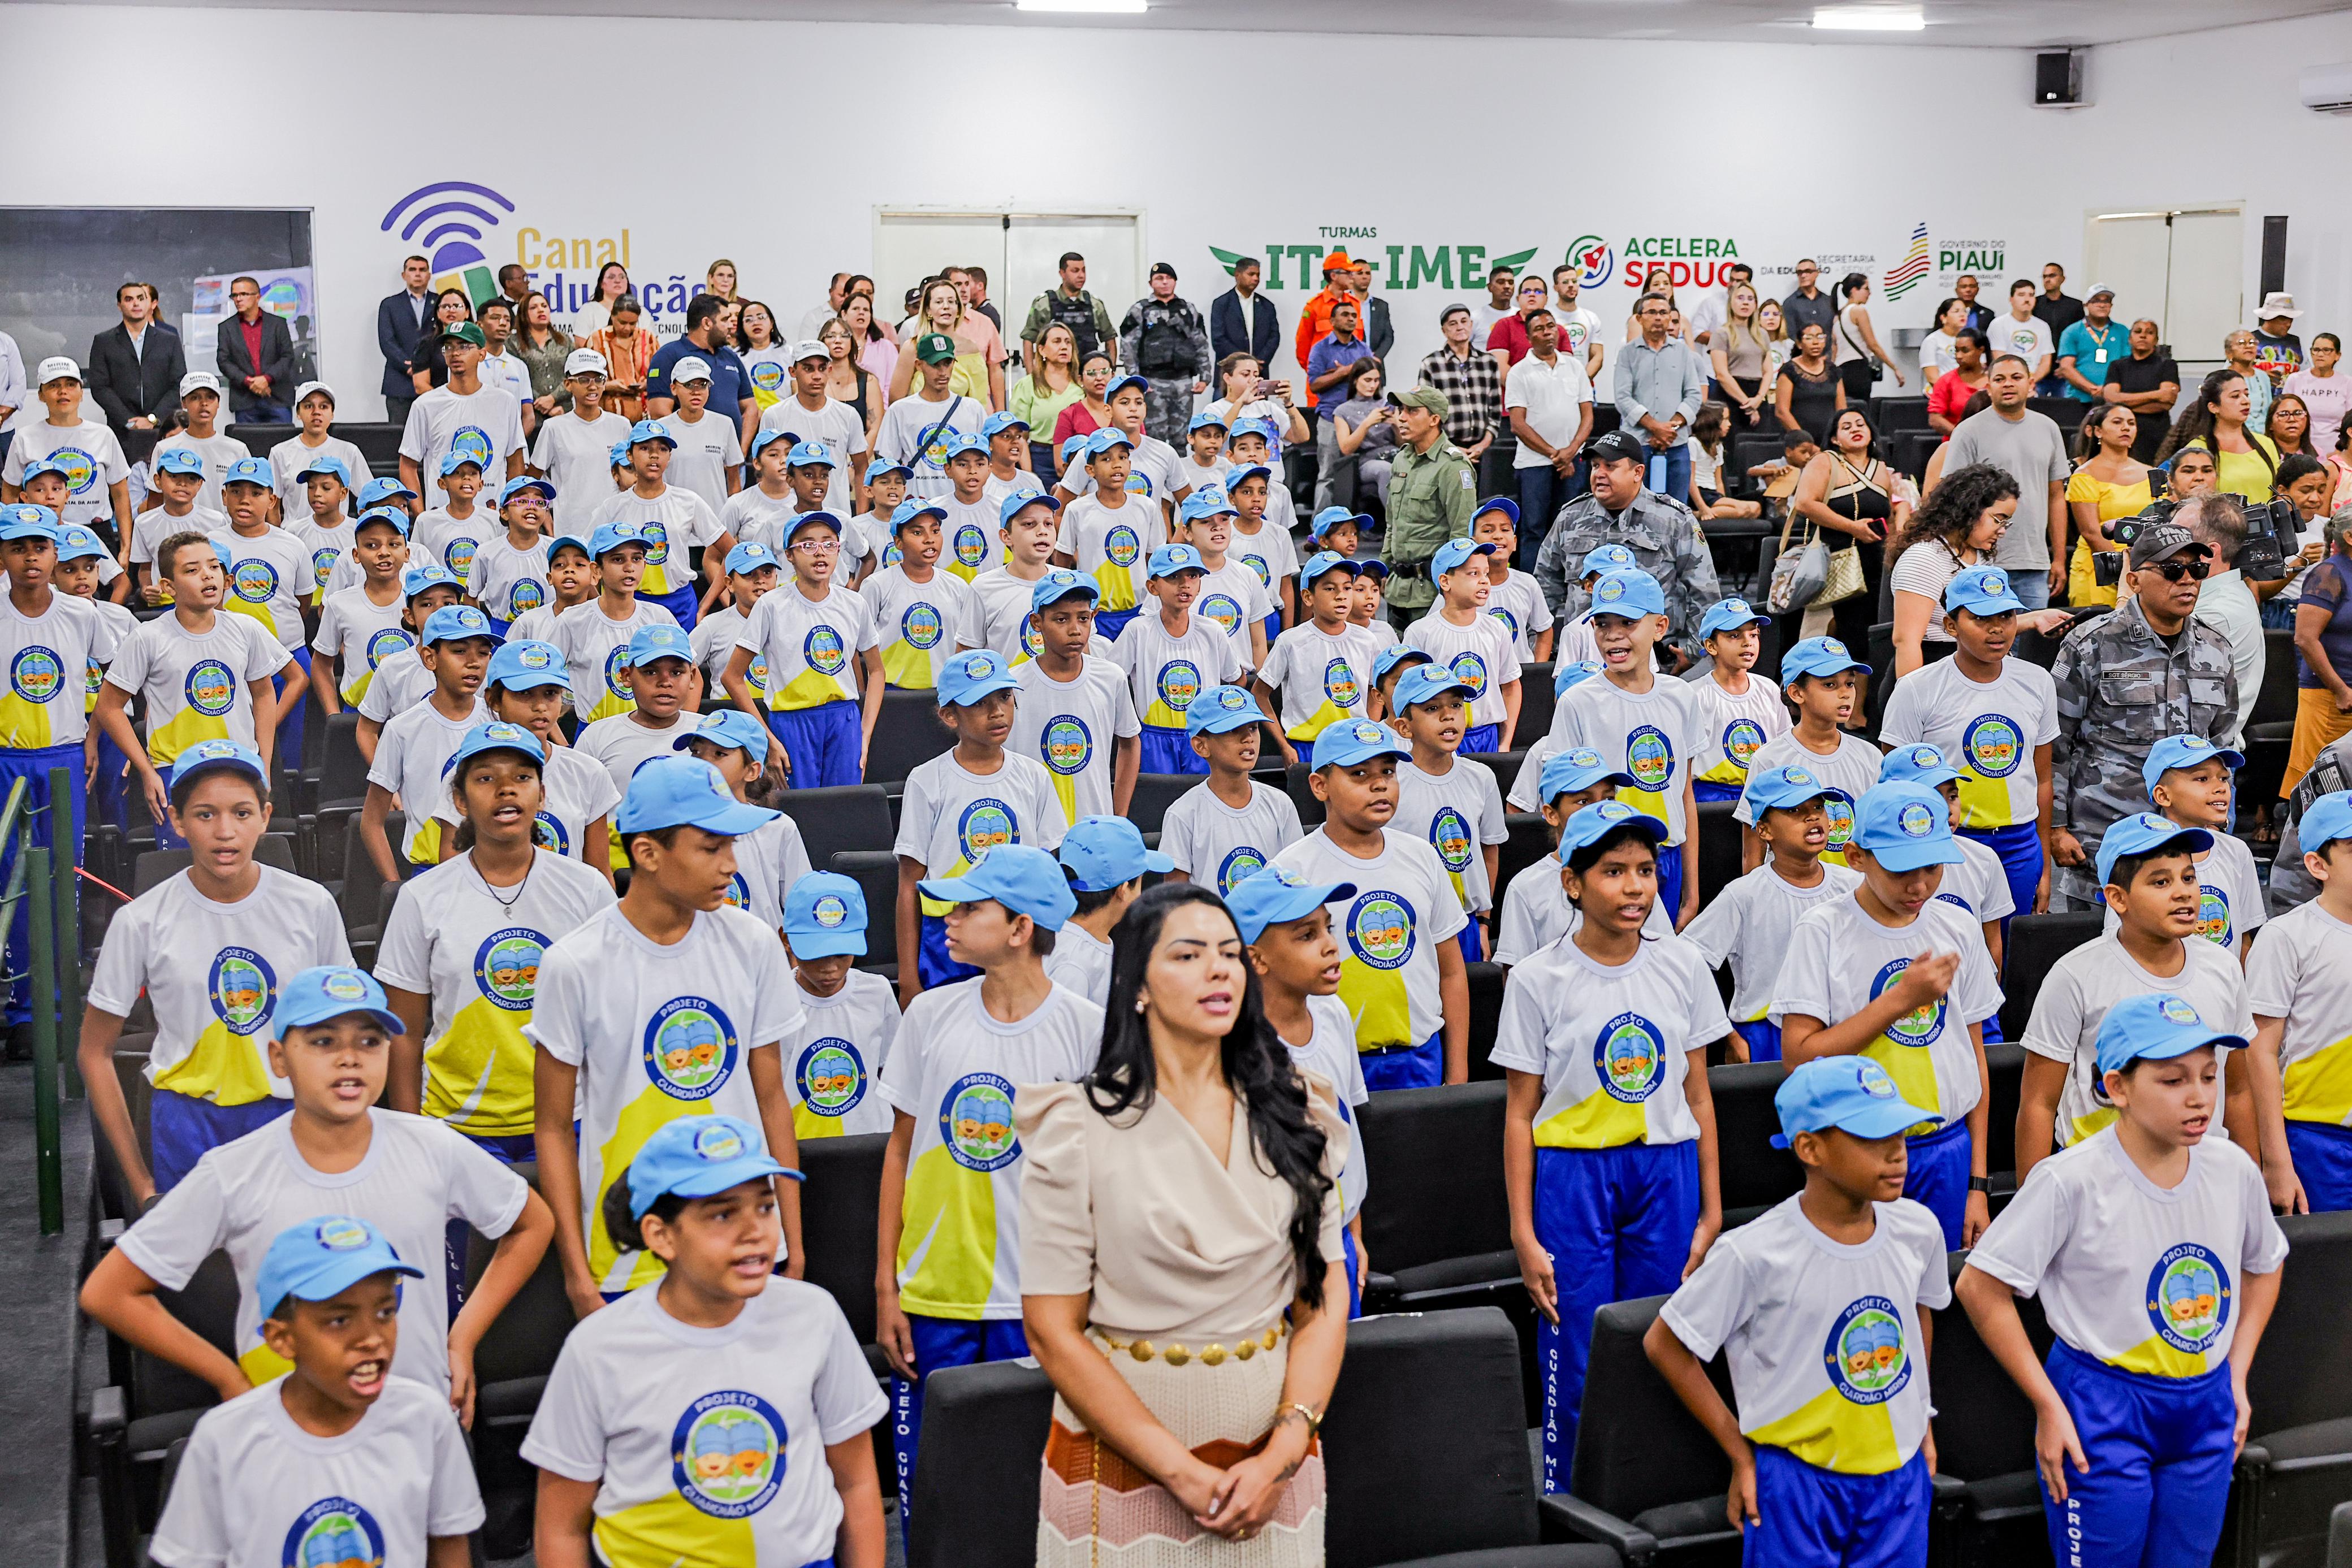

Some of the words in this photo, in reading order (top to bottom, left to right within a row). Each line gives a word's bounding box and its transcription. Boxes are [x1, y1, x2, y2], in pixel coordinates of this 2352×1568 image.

[1319, 227, 1377, 238] TURMAS
[517, 227, 629, 270] Canal
[1624, 237, 1738, 257] ACELERA
[1817, 255, 1876, 263] SECRETARIA
[1939, 250, 2004, 271] PIAUÍ
[1777, 265, 1830, 275] EDUÃO
[238, 592, 263, 603] GUARDIÃO
[377, 629, 403, 638] PROJETO
[906, 636, 927, 648] GUARDIÃO
[23, 646, 51, 656] PROJETO
[196, 661, 222, 670] PROJETO
[831, 663, 844, 674] MIRIM
[750, 678, 765, 689] GUARD
[17, 688, 44, 703] GUARDIÃO
[44, 688, 59, 701] MIRIM
[1347, 695, 1360, 706] MIRIM
[193, 703, 221, 716] GUARDIÃO
[221, 701, 235, 713] MIRIM
[1162, 696, 1184, 710] GUARDIÃO
[1975, 715, 2007, 725] PROJETO
[1047, 760, 1071, 774] GUARDIÃO
[1071, 760, 1087, 773] MIRIM
[1730, 756, 1749, 768] GUARDI
[1972, 762, 2003, 777] GUARDIÃO
[2003, 760, 2018, 774] MIRIM
[1659, 780, 1671, 790] MIR
[970, 800, 1003, 811] PROJETO
[1231, 848, 1259, 858] PROJETO
[2200, 887, 2220, 896] OJETO
[1359, 893, 1397, 906] PROJETO
[491, 929, 536, 943] PROJETO
[1358, 951, 1396, 969] GUARDIÃO
[1396, 948, 1412, 965] MIRIM
[1886, 961, 1910, 973] PROJ
[487, 990, 528, 1009] GUARDIÃO
[660, 999, 707, 1017] PROJETO
[1926, 1025, 1942, 1043] MIRIM
[811, 1039, 848, 1052] PROJETO
[656, 1077, 704, 1099] GUARDIÃO
[705, 1067, 729, 1095] MIRIM
[962, 1075, 1009, 1091] PROJETO
[840, 1096, 859, 1113] MIRIM
[1845, 1299, 1891, 1318] PROJETO
[1839, 1382, 1883, 1403] GUARDIÃO
[1884, 1373, 1908, 1398] MIRIM
[695, 1392, 758, 1413] PROJETO
[1547, 1349, 1558, 1443] GUARDIÃO
[897, 1381, 910, 1436] JETO
[1545, 1454, 1556, 1493] MIR
[682, 1485, 745, 1517] GUARDIÃO
[2068, 1498, 2082, 1568] PROJE
